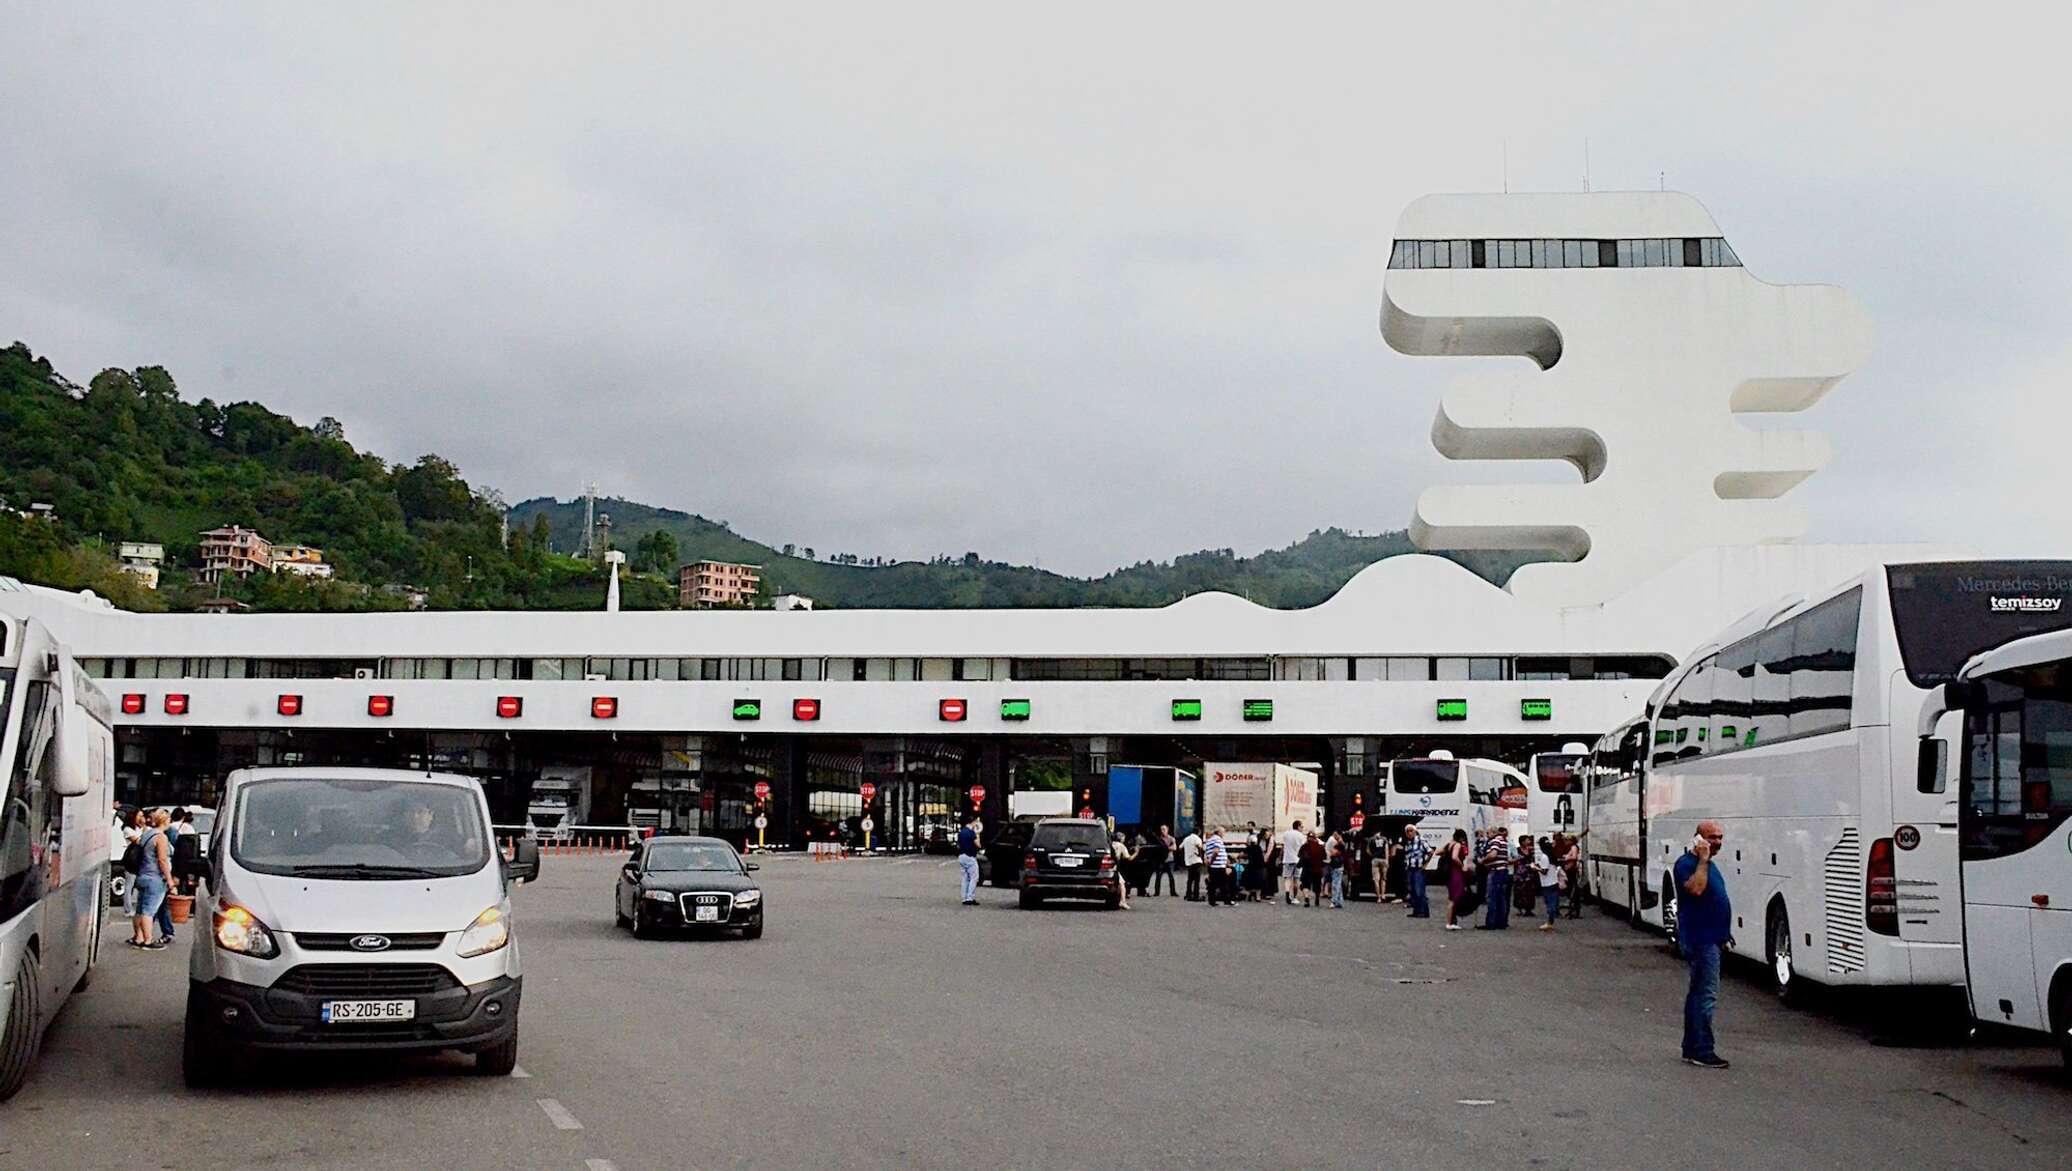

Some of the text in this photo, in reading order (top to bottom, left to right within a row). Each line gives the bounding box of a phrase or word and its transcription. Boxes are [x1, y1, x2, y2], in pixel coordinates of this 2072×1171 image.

[1991, 595, 2061, 610] temizsoy
[860, 786, 875, 795] STOP
[970, 789, 985, 797] STOP
[1900, 832, 1917, 843] 100
[358, 937, 381, 946] Ford
[333, 1002, 403, 1017] RS-205-GE
